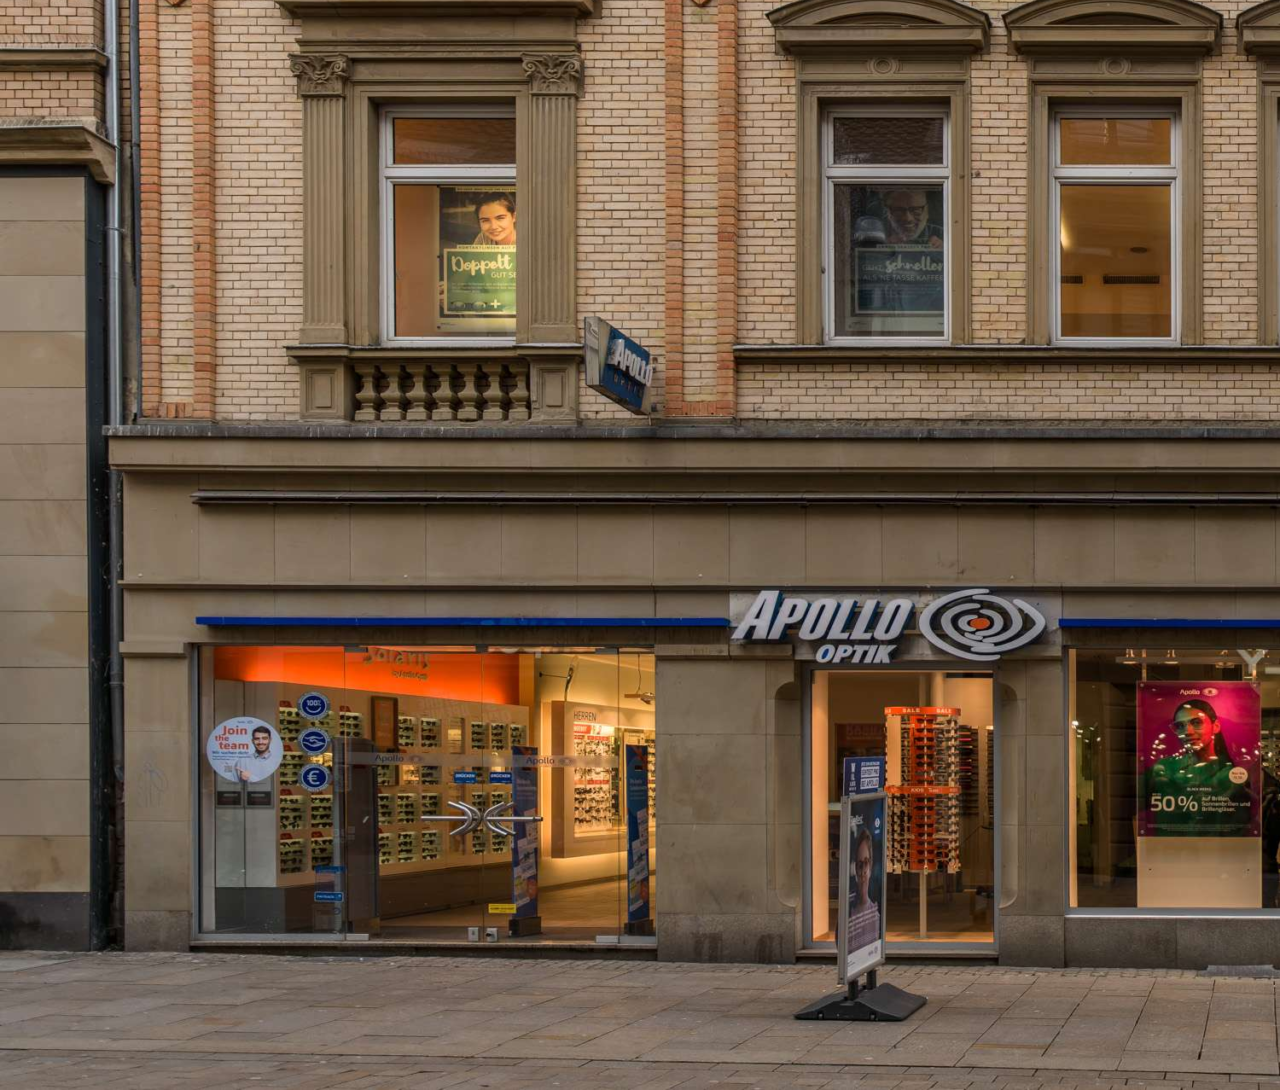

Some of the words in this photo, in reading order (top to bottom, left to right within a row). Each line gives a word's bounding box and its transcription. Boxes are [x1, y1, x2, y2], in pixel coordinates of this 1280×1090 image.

[451, 254, 513, 276] Doppelt
[611, 339, 653, 387] APOLLO
[731, 590, 915, 640] APOLLO
[816, 644, 897, 664] OPTIK
[1180, 688, 1200, 696] Apollo
[574, 711, 596, 722] HERREN
[222, 726, 248, 736] Join
[219, 742, 249, 750] team
[375, 754, 404, 763] Apollo
[526, 756, 554, 765] Apollo
[1151, 796, 1175, 812] 50
[1178, 795, 1198, 812] %
